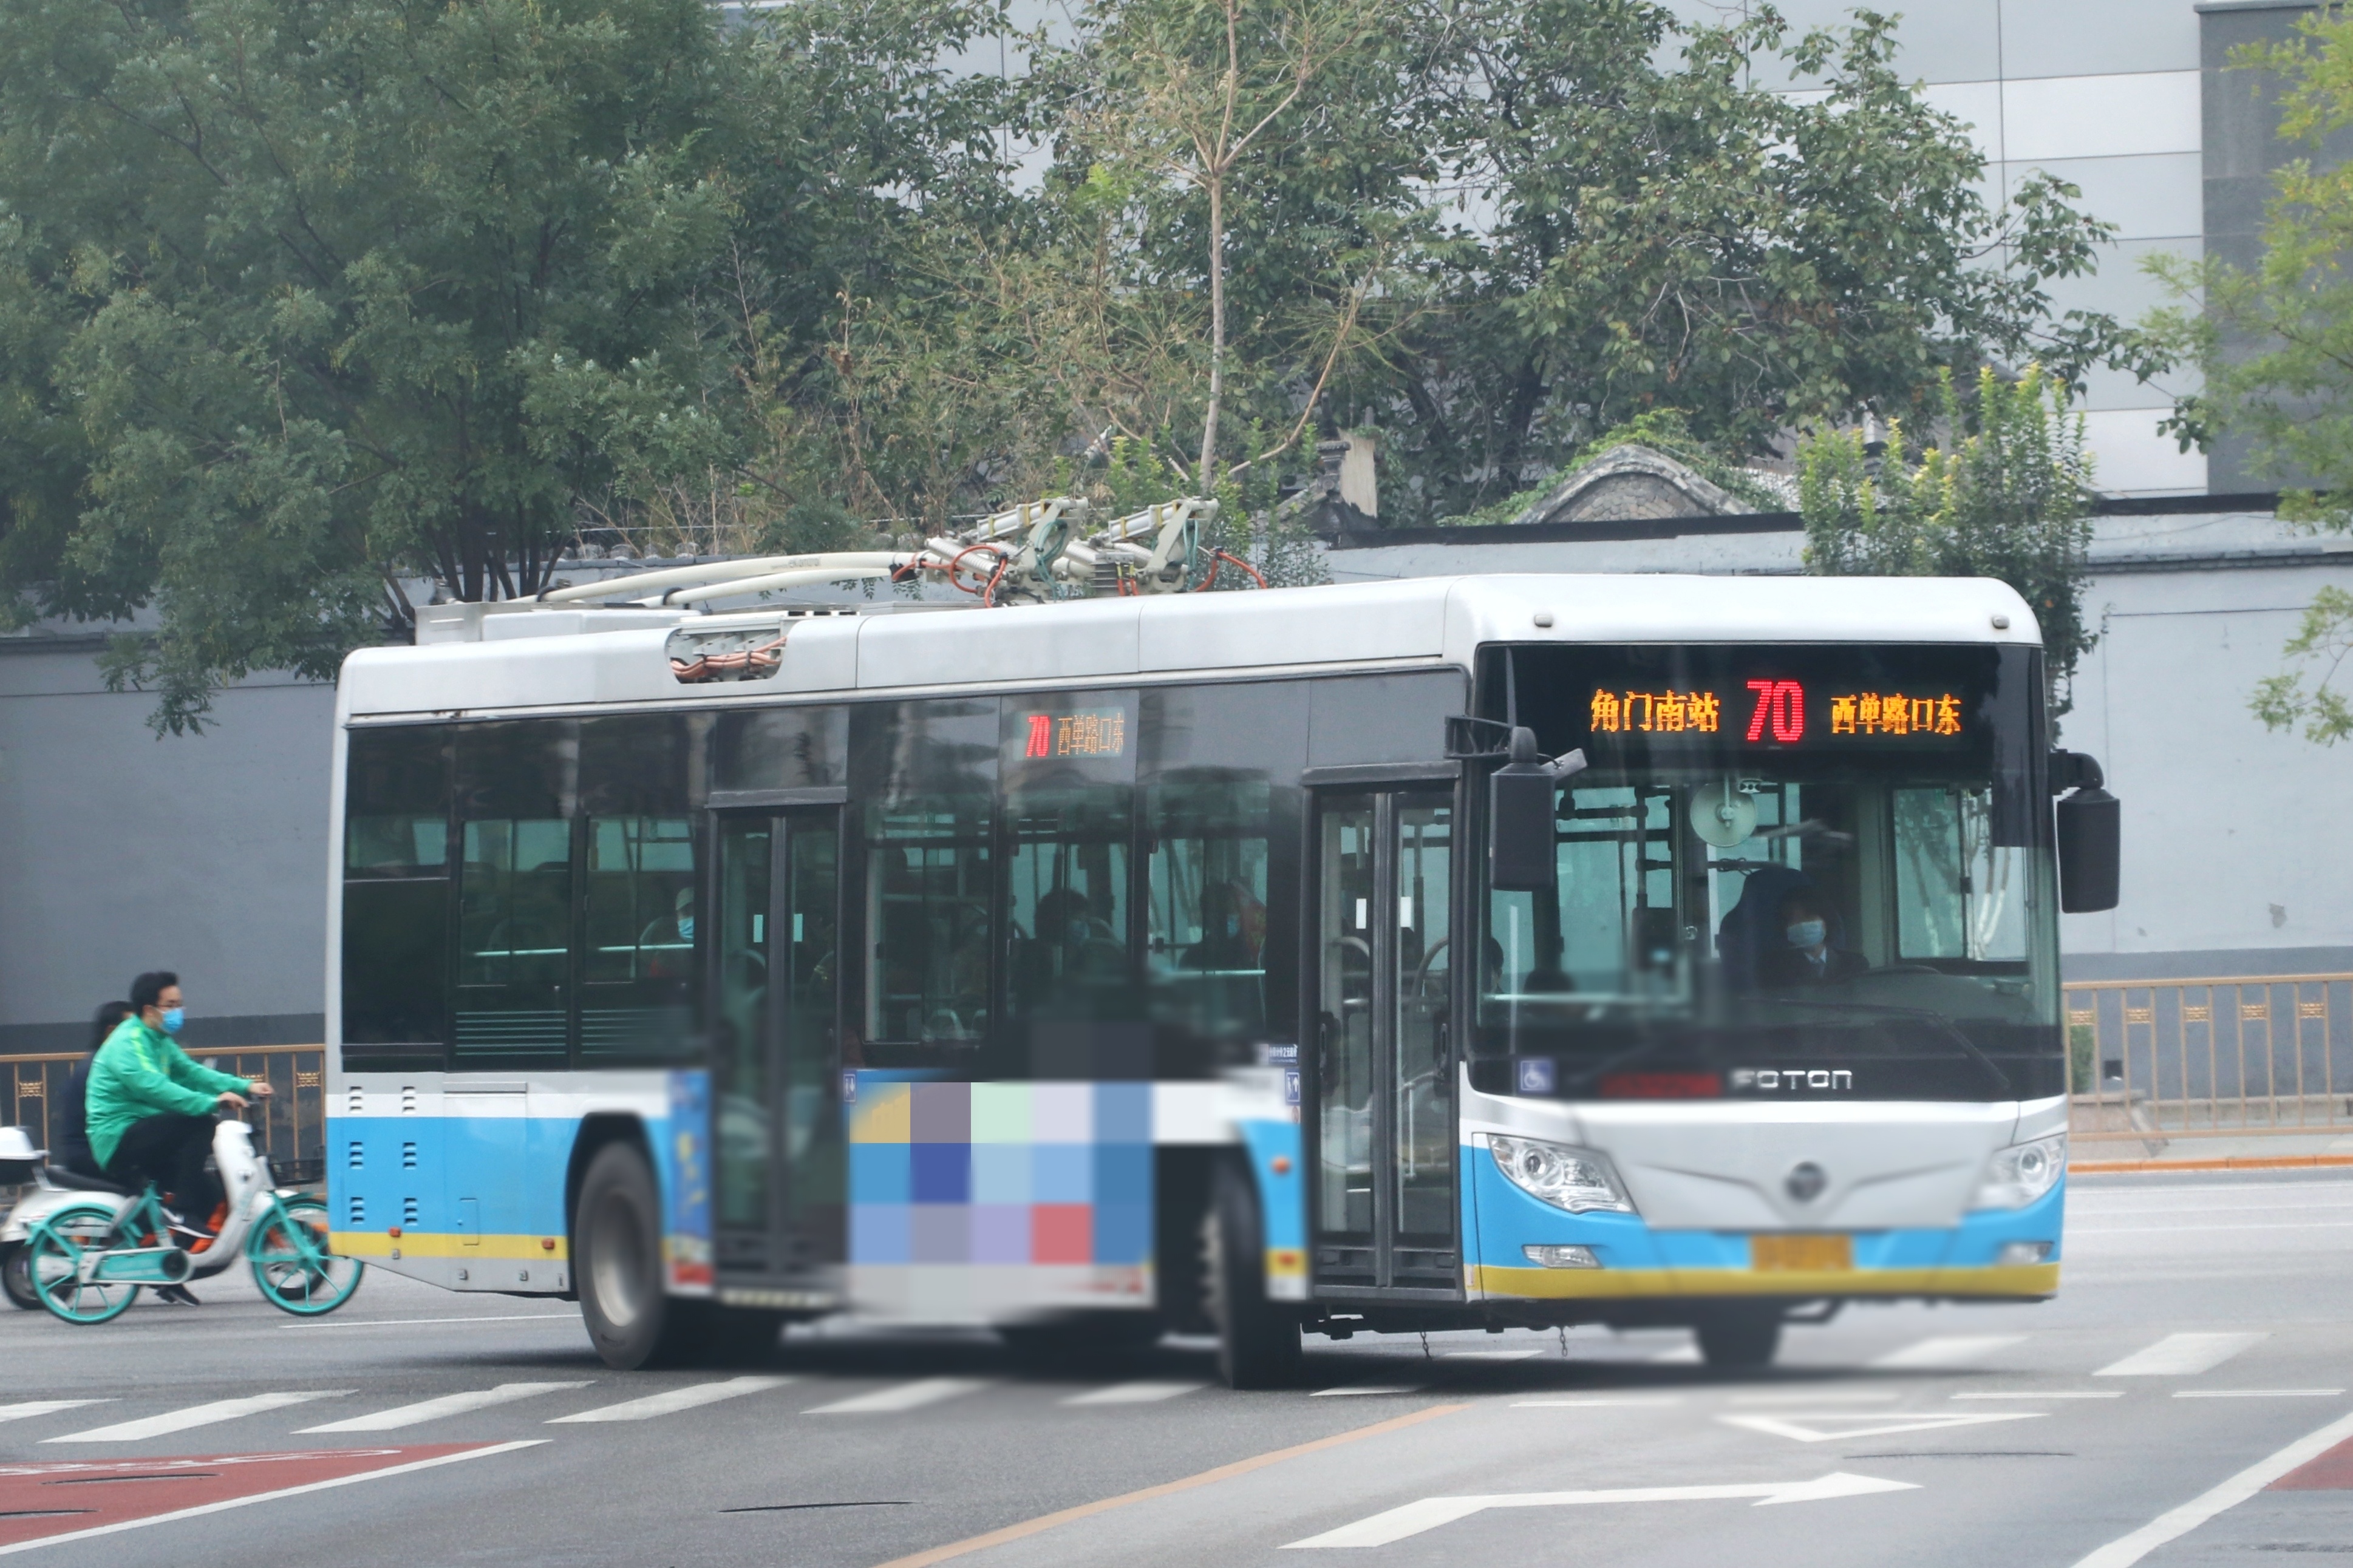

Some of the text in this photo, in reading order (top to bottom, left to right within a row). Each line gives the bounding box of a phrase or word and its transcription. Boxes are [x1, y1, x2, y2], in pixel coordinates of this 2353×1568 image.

[1591, 680, 1961, 741] 角门南站 70 西单路口东
[1026, 713, 1123, 757] 70 西单路口东
[1732, 1070, 1852, 1090] FOTON
